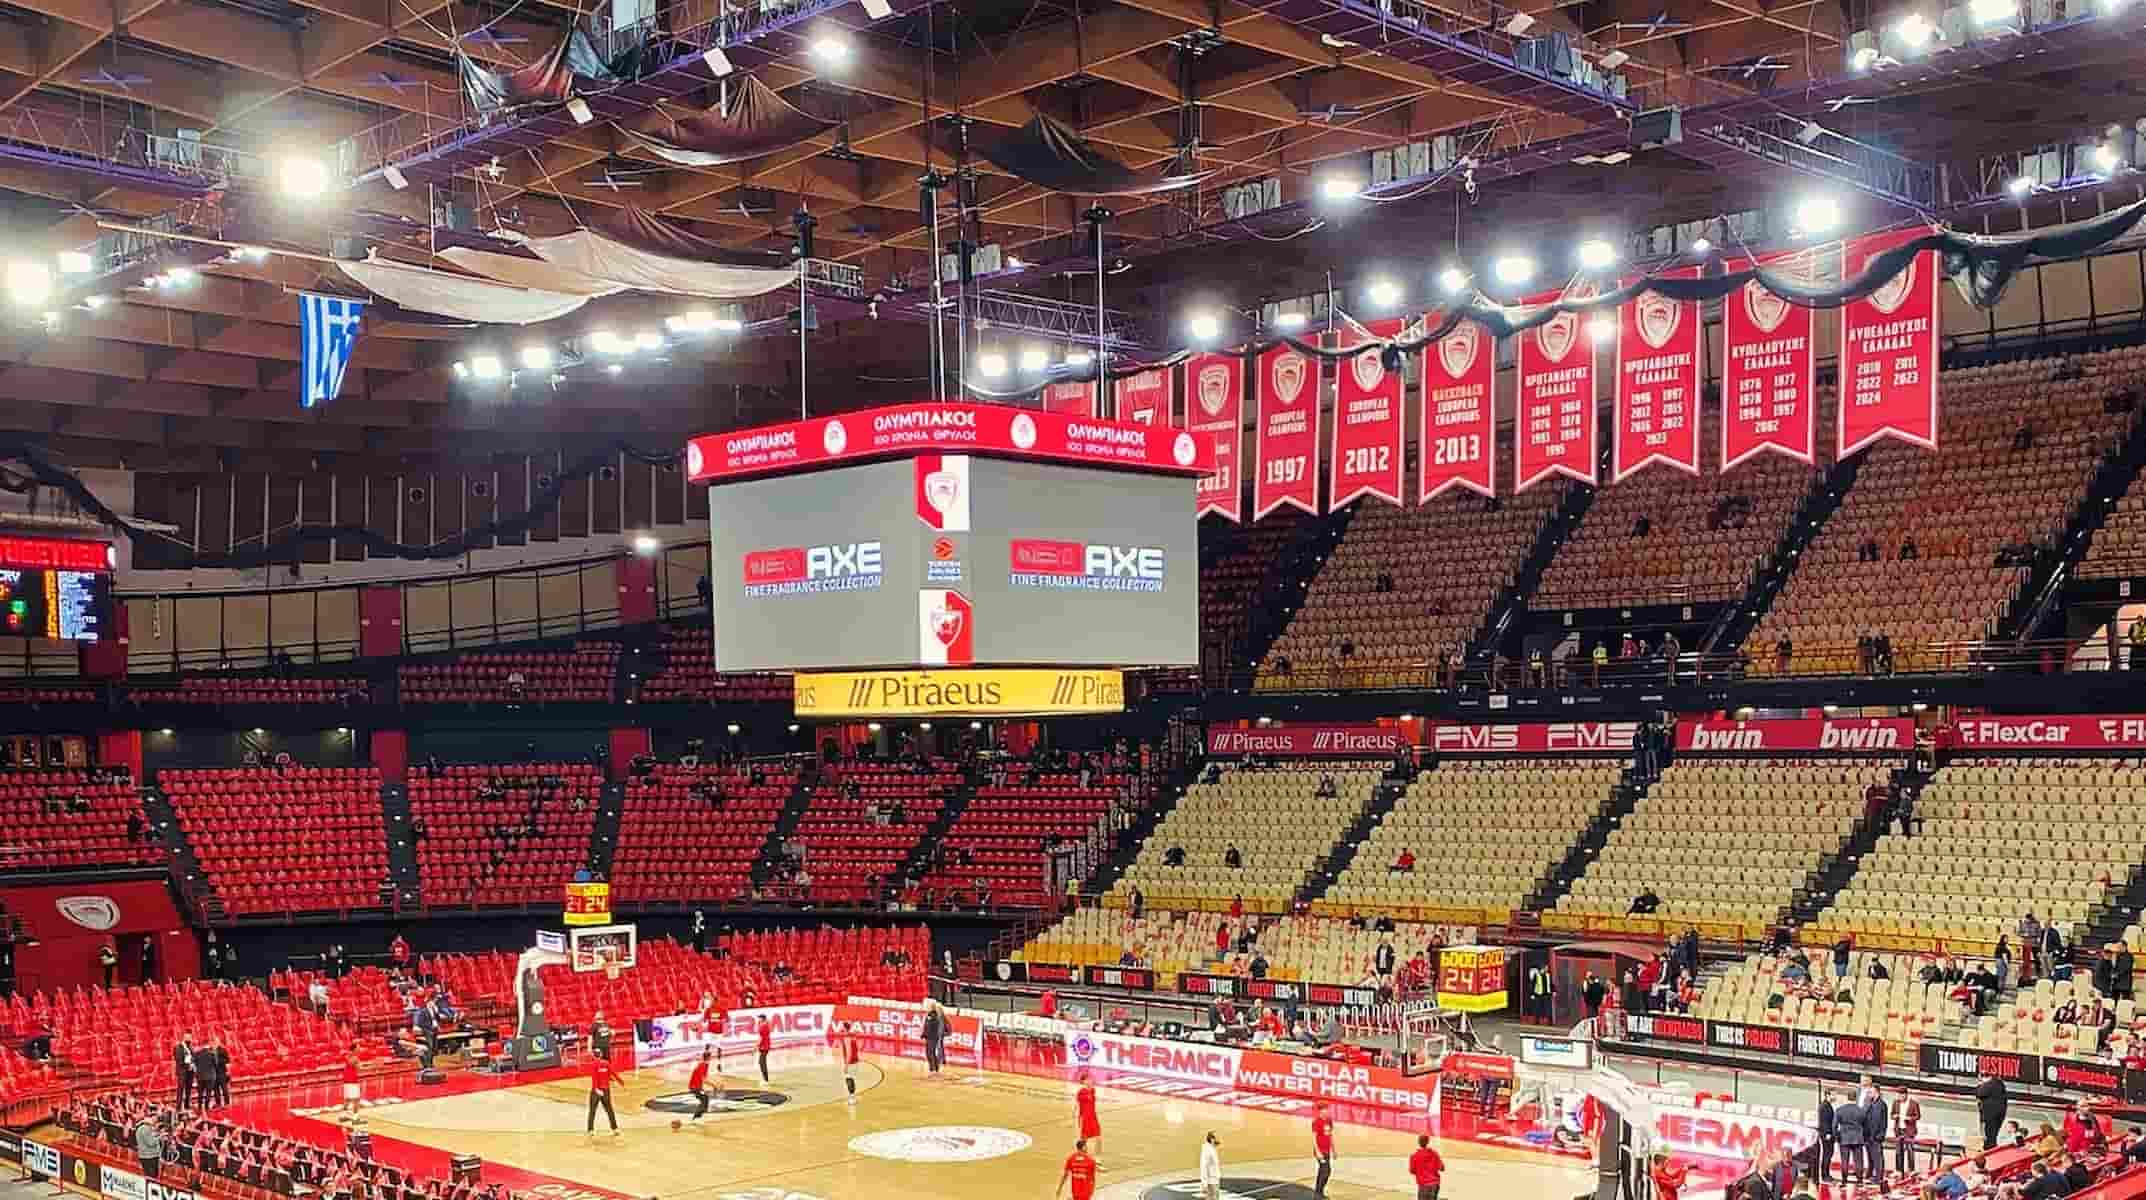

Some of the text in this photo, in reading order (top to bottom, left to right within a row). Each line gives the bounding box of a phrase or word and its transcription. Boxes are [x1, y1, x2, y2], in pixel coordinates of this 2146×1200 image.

[1344, 446, 1390, 475] 2012
[1435, 435, 1480, 465] 2013
[1266, 456, 1307, 484] 1997
[807, 542, 881, 579] AXE
[1086, 545, 1164, 578] AXE
[823, 575, 881, 592] COLLECTION
[1101, 578, 1162, 591] COLLECTION
[882, 677, 1001, 706] Piraeus
[1232, 734, 1293, 750] Piraeus
[1333, 732, 1397, 749] Piraeus
[1435, 725, 1519, 748] FMS
[1691, 723, 1764, 749] bwin
[1820, 719, 1898, 749] bwin
[1979, 720, 2070, 743] FlexCar
[585, 896, 606, 912] 24
[1446, 968, 1501, 992] 24 24
[879, 1010, 926, 1025] SOLA
[1797, 1034, 1874, 1061] FOREVER CHAMPS
[1291, 1060, 1370, 1082] SOLAR
[1937, 1050, 2021, 1078] TEAM OF DESTINY
[1239, 1070, 1428, 1108] WATER HEATERS
